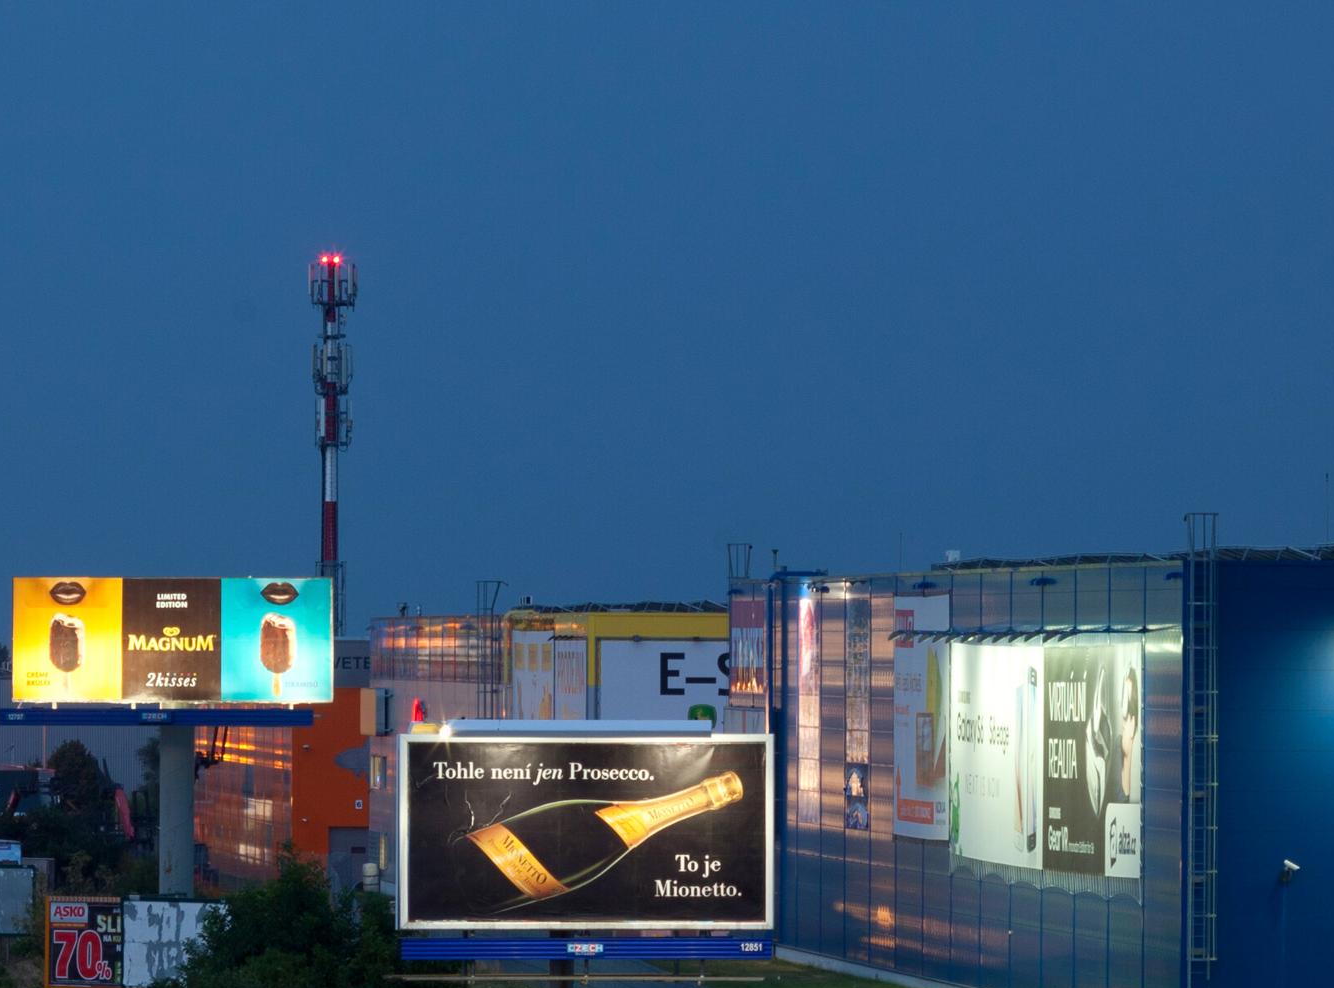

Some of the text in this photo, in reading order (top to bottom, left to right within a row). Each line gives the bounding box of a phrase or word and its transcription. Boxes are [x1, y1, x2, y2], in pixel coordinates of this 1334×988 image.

[127, 634, 214, 652] MAGNUM
[145, 672, 197, 687] 2kisses
[1048, 670, 1087, 722] VIRTUÁLNÍ
[1049, 738, 1077, 779] REALITA
[433, 761, 655, 785] Tohle není jen Prosecco.
[675, 854, 721, 877] To je
[655, 880, 742, 898] Mionetto.
[567, 943, 603, 953] CZECH
[741, 943, 763, 952] 12851
